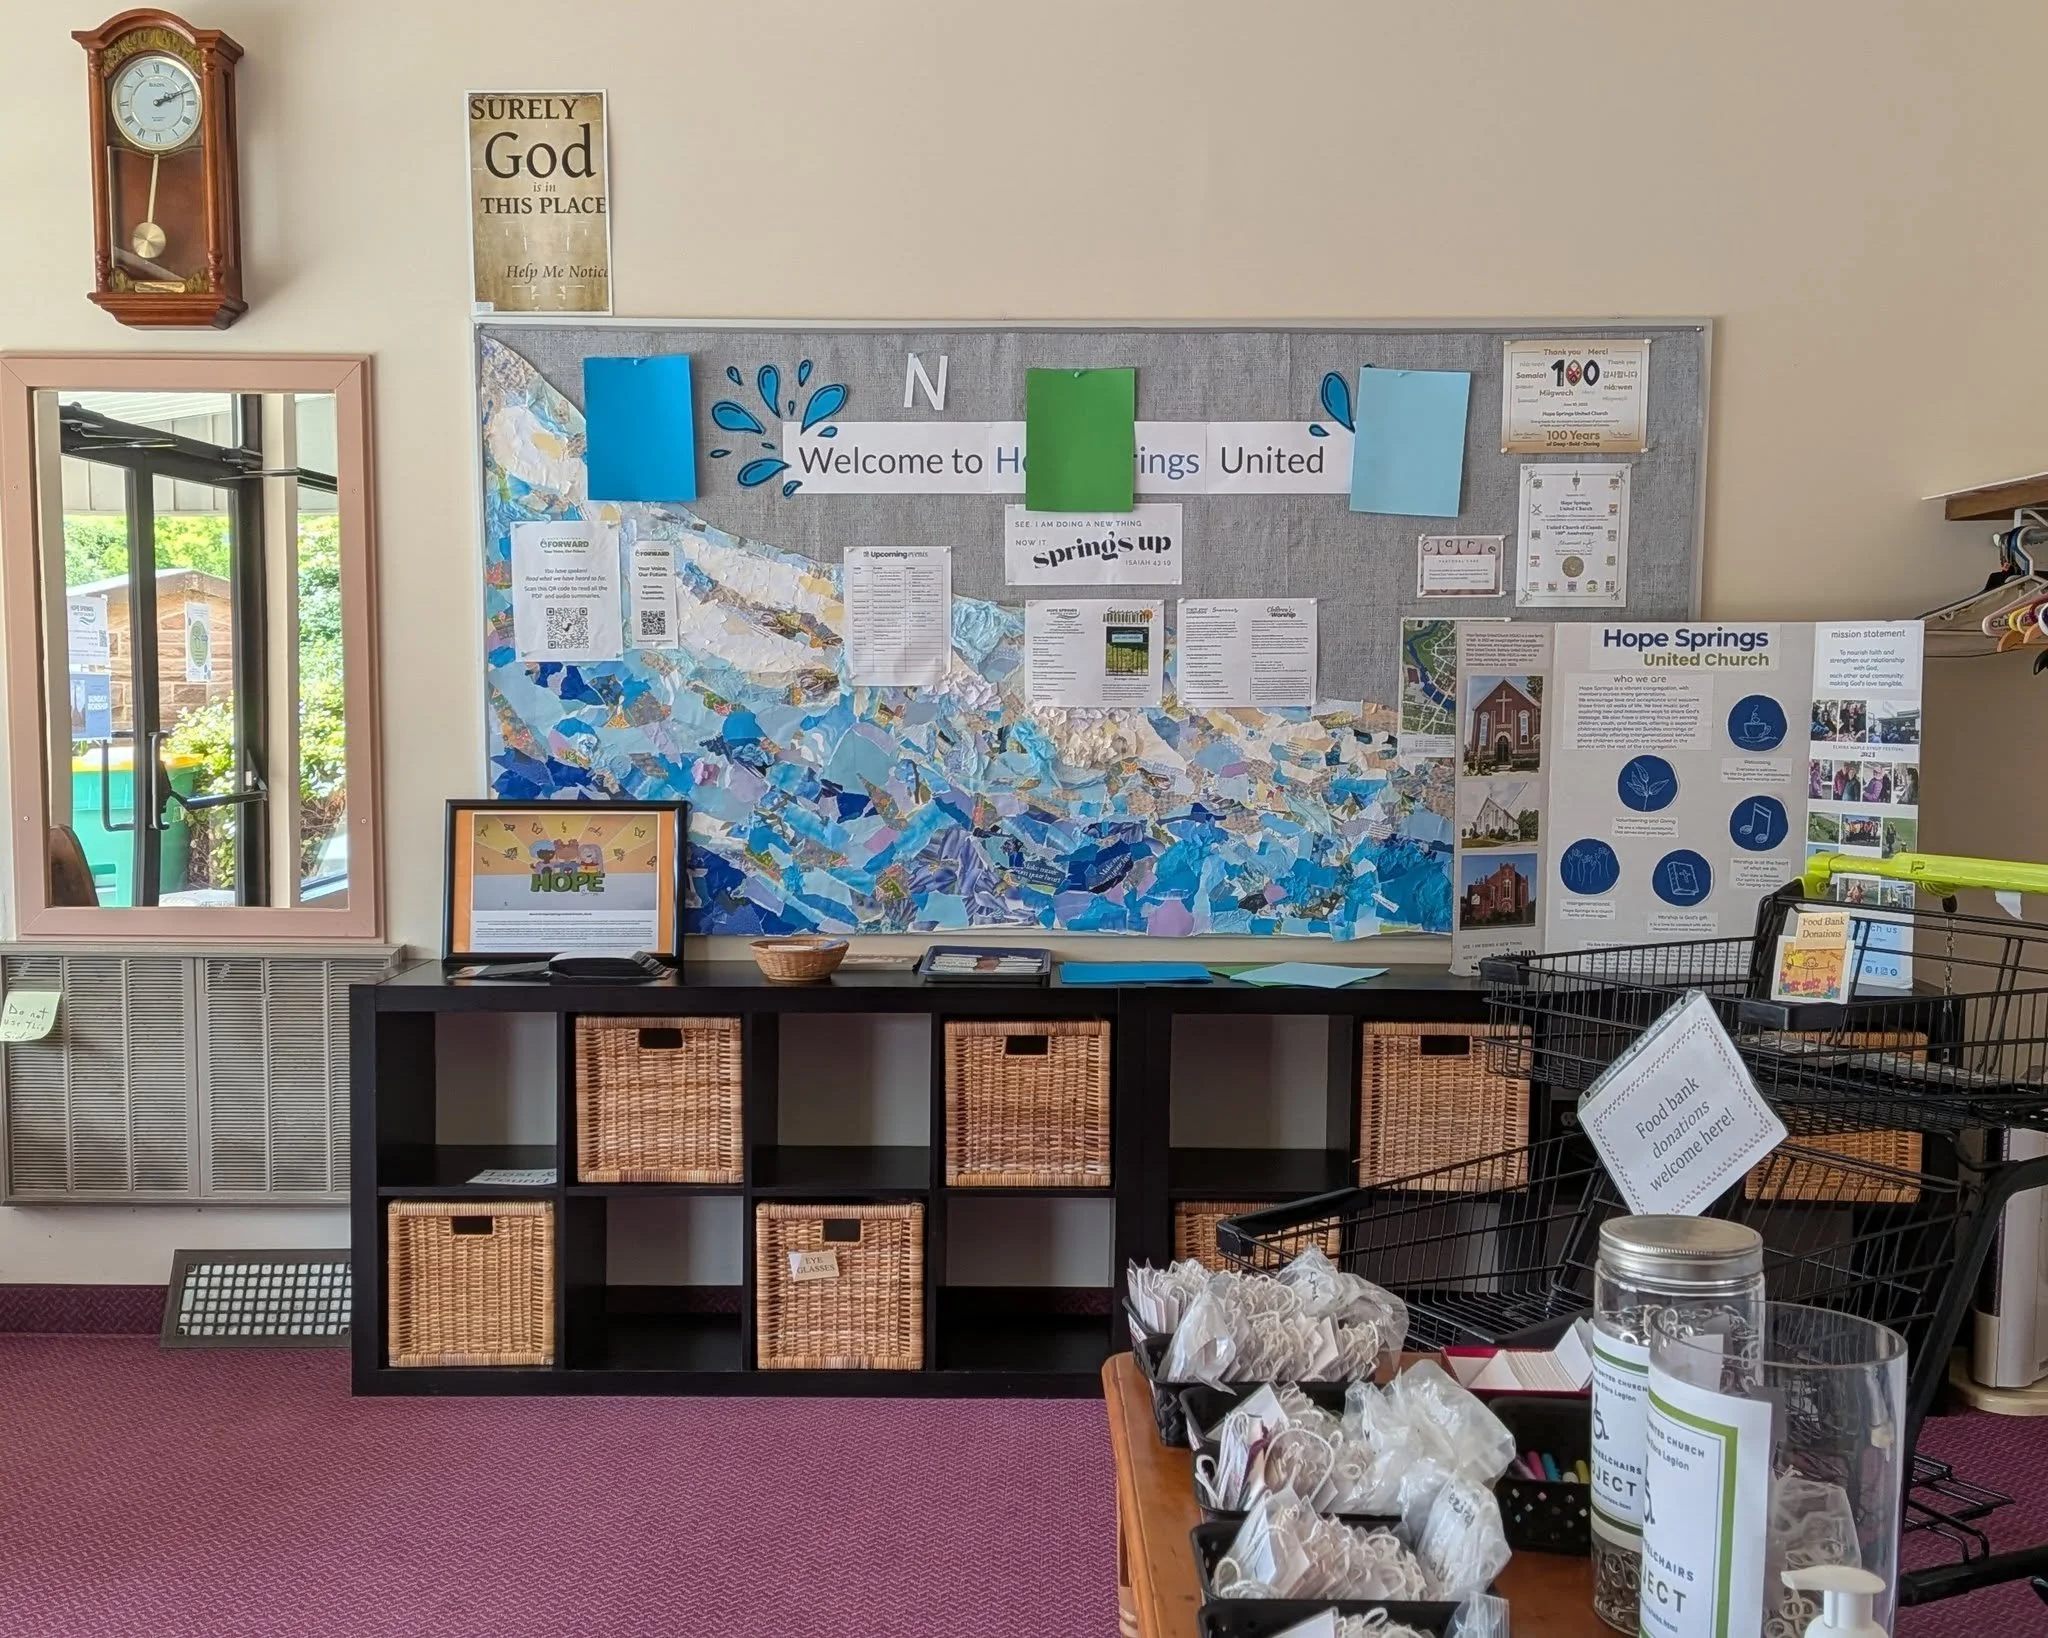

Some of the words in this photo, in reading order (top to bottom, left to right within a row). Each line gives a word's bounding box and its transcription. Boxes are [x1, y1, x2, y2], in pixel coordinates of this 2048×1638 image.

[471, 99, 578, 120] SURELY
[485, 123, 597, 179] God
[533, 182, 542, 192] is
[546, 182, 556, 192] in
[480, 197, 532, 214] THIS
[540, 196, 606, 214] PLACE
[507, 263, 538, 284] Help
[544, 265, 564, 278] Me
[903, 353, 948, 411] N
[1551, 360, 1600, 386] 100
[1547, 430, 1567, 440] 100
[1569, 430, 1600, 440] Years
[798, 447, 943, 474] Welcome
[952, 448, 983, 474] to
[1134, 446, 1200, 480] ings
[1221, 446, 1324, 474] United
[1138, 536, 1172, 554] up
[1604, 629, 1669, 651] Hope
[1675, 627, 1768, 651] Springs
[1831, 630, 1861, 638] mission
[1863, 630, 1906, 638] statement
[1644, 652, 1700, 666] United
[1705, 652, 1769, 666] Church
[1614, 675, 1633, 683] who
[530, 872, 605, 893] HOPE
[1824, 917, 1845, 926] Bank
[1802, 930, 1842, 938] Donations
[1634, 1105, 1669, 1140] Food
[1671, 1077, 1700, 1111] bank
[1652, 1100, 1710, 1159] donations
[1650, 1138, 1704, 1192] welcome
[1705, 1107, 1736, 1147] here!
[797, 1264, 835, 1273] GLASSES
[1614, 1389, 1636, 1402] Legion
[1618, 1379, 1648, 1392] CHURCH
[1667, 1436, 1704, 1458] CHURCH
[1663, 1450, 1690, 1471] Legion
